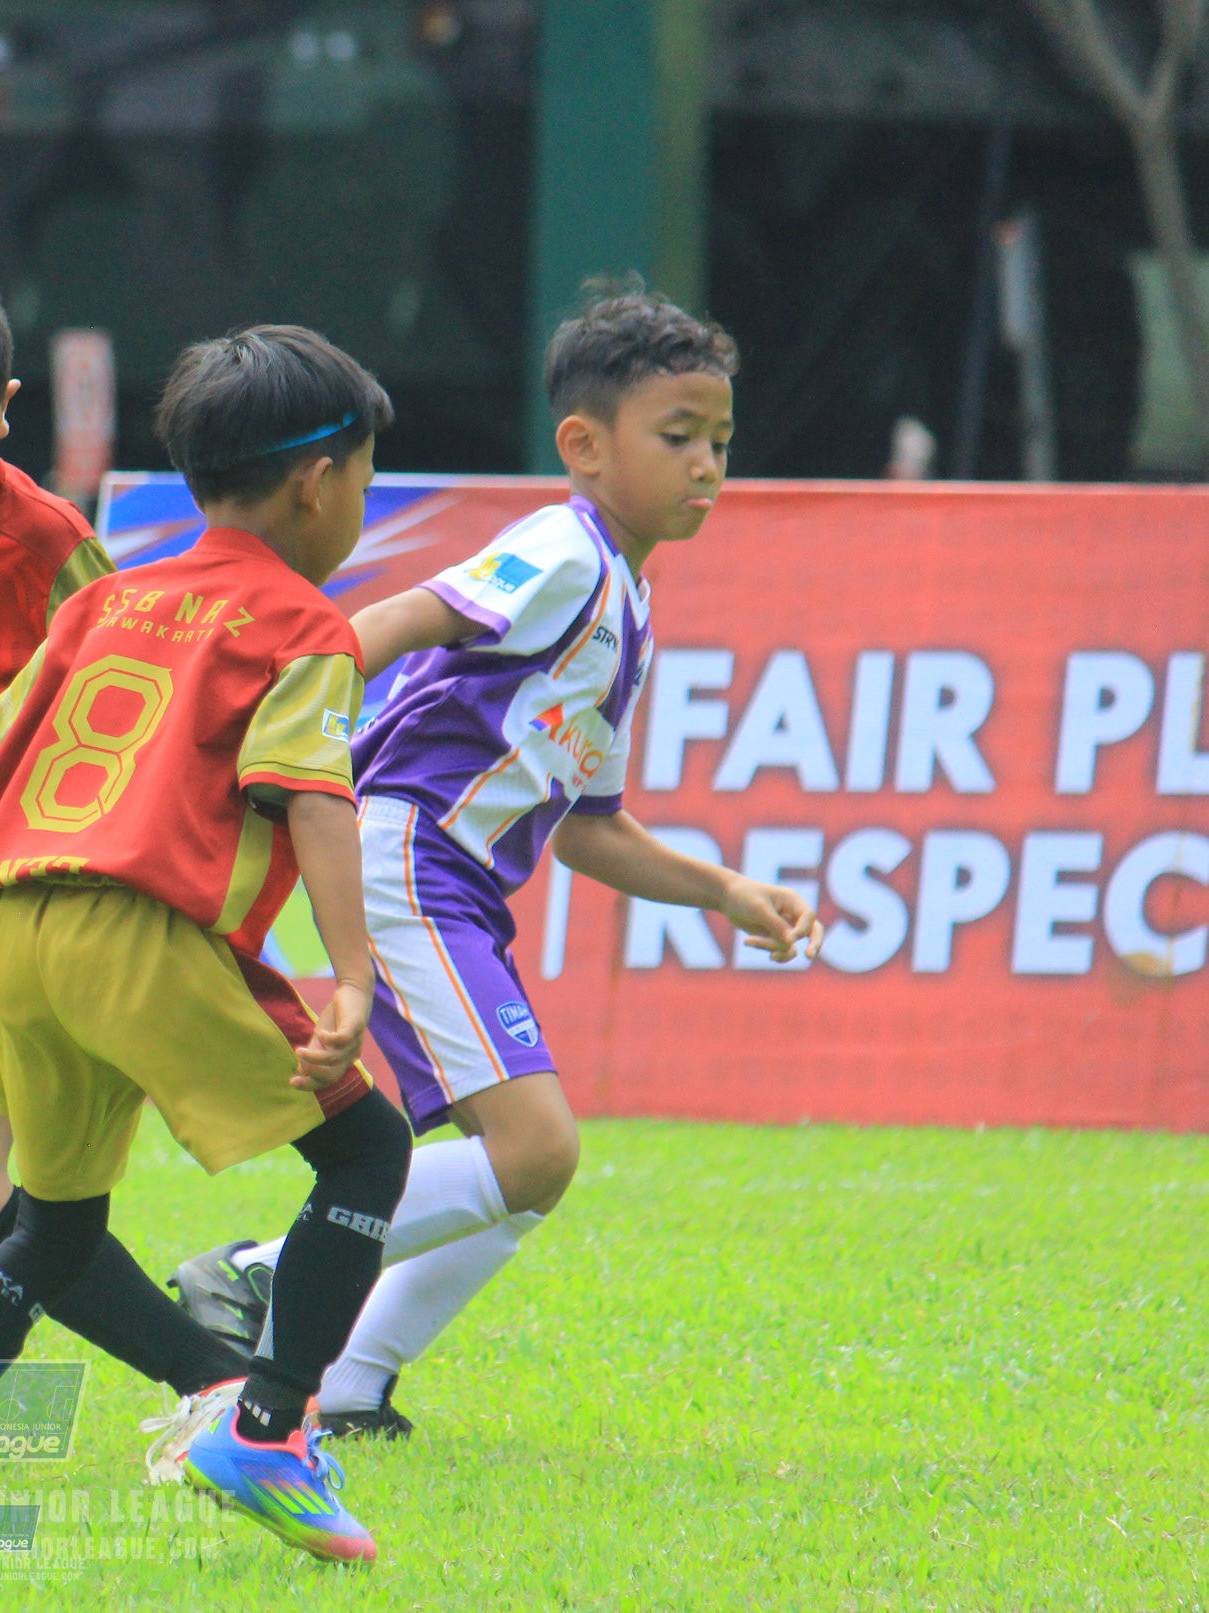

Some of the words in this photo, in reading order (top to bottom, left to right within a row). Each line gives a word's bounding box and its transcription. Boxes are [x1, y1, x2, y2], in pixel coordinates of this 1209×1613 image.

[97, 588, 166, 624] SSB
[174, 592, 256, 638] NAZ
[19, 653, 175, 834] 8
[641, 648, 996, 794] FAIR
[1054, 650, 1209, 796] PL
[624, 825, 1209, 977] RESPEC
